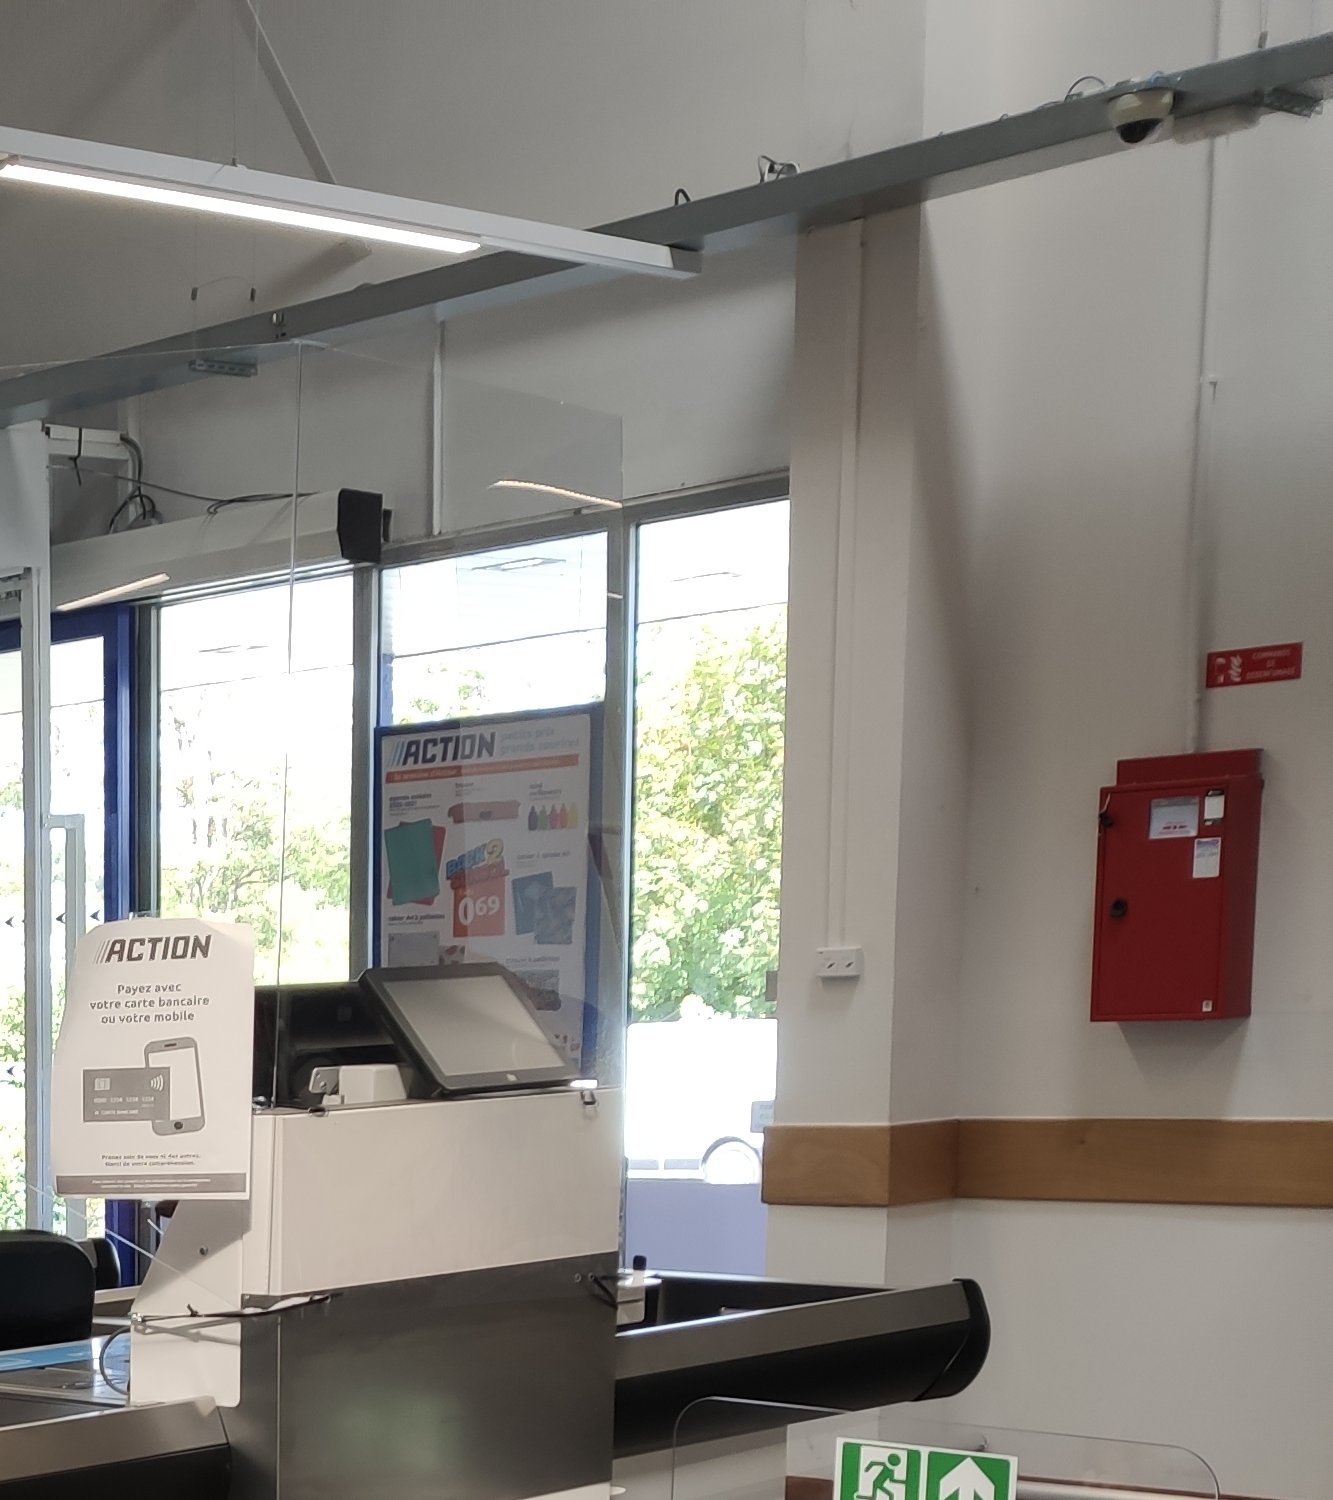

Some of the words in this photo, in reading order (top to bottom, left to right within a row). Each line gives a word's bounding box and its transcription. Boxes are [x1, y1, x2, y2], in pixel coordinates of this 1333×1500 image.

[402, 732, 496, 766] ACTION
[105, 934, 212, 964] ACTION
[117, 983, 151, 995] Payez
[155, 982, 182, 993] avec
[89, 1000, 121, 1010] votre
[124, 998, 155, 1009] carte
[158, 995, 210, 1008] bancaire
[101, 1015, 116, 1024] ou
[119, 1013, 151, 1024] votre
[154, 1011, 195, 1023] mobile
